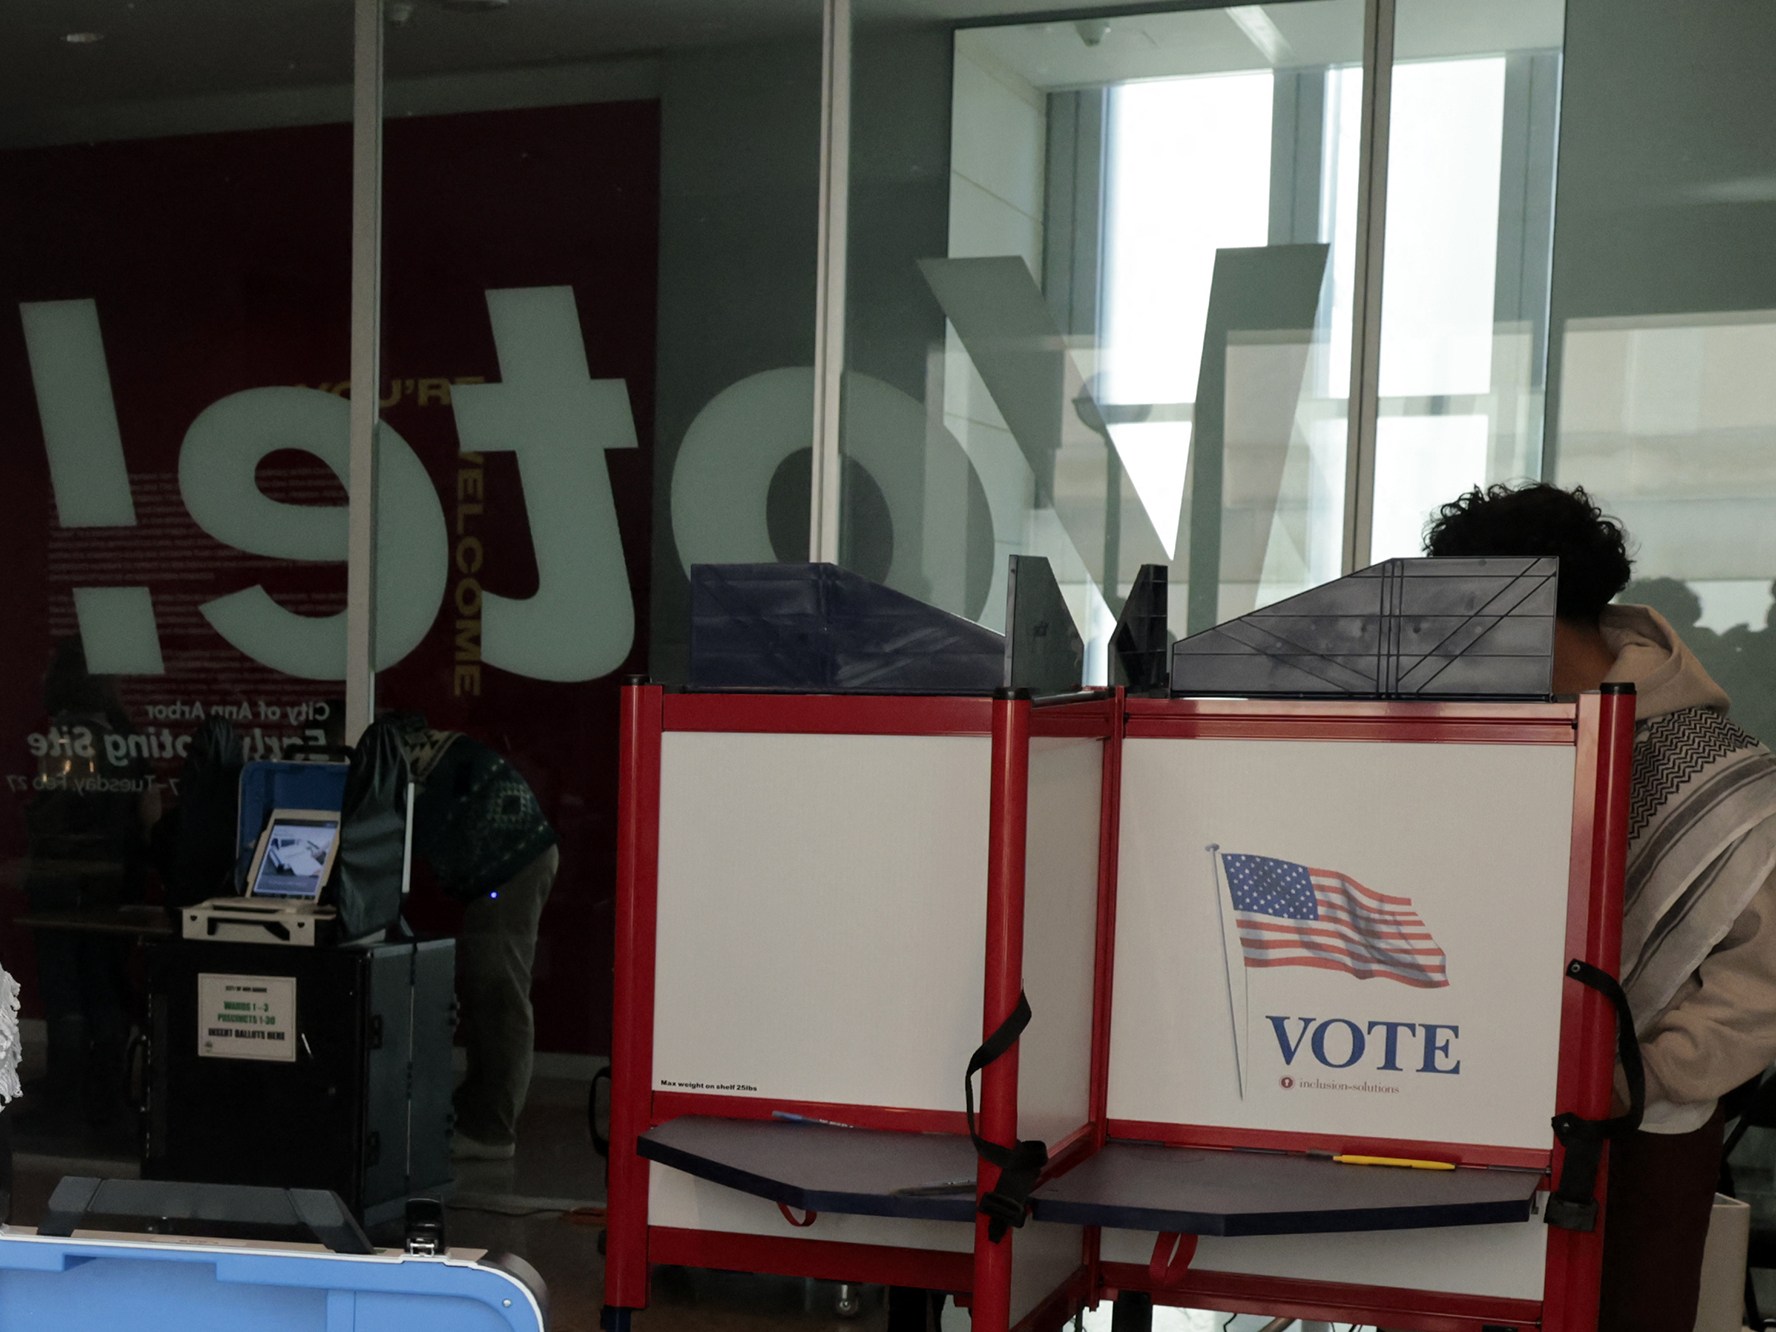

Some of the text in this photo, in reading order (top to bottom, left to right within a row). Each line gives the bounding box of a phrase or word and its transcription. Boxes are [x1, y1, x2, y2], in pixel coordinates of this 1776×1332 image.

[1264, 1014, 1461, 1075] VOTE
[660, 1079, 677, 1087] Max
[677, 1081, 704, 1090] weight
[716, 1083, 736, 1091] shelf
[736, 1084, 758, 1092] 25lbs
